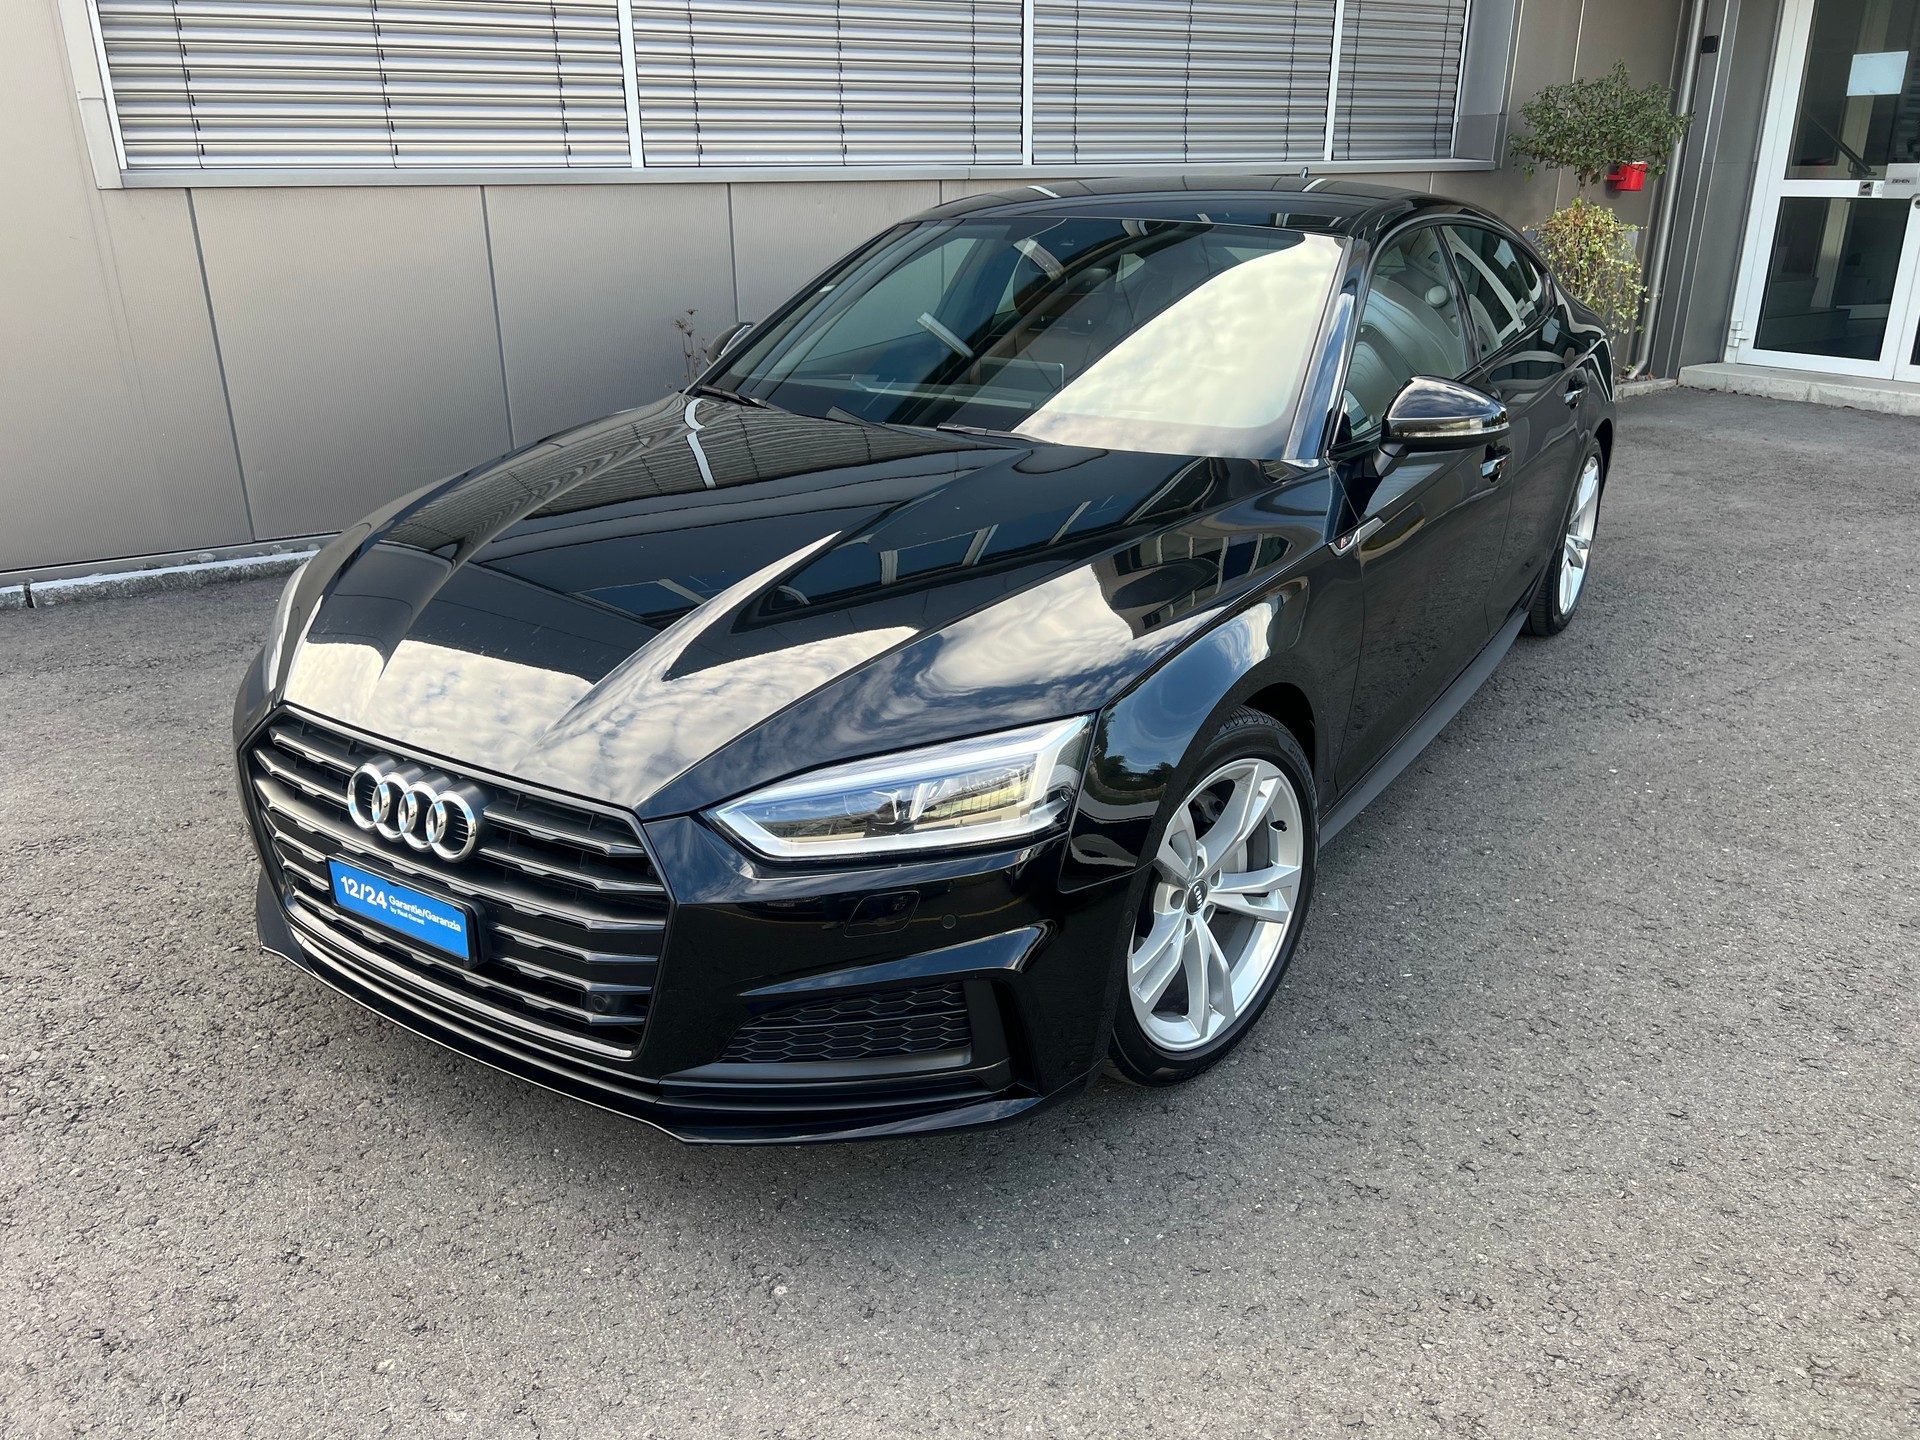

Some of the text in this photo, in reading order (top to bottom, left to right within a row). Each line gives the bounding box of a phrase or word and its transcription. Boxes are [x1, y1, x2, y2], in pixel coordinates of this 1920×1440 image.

[341, 875, 461, 933] 12/24 Garantie/Garanzia
[390, 906, 397, 915] by
